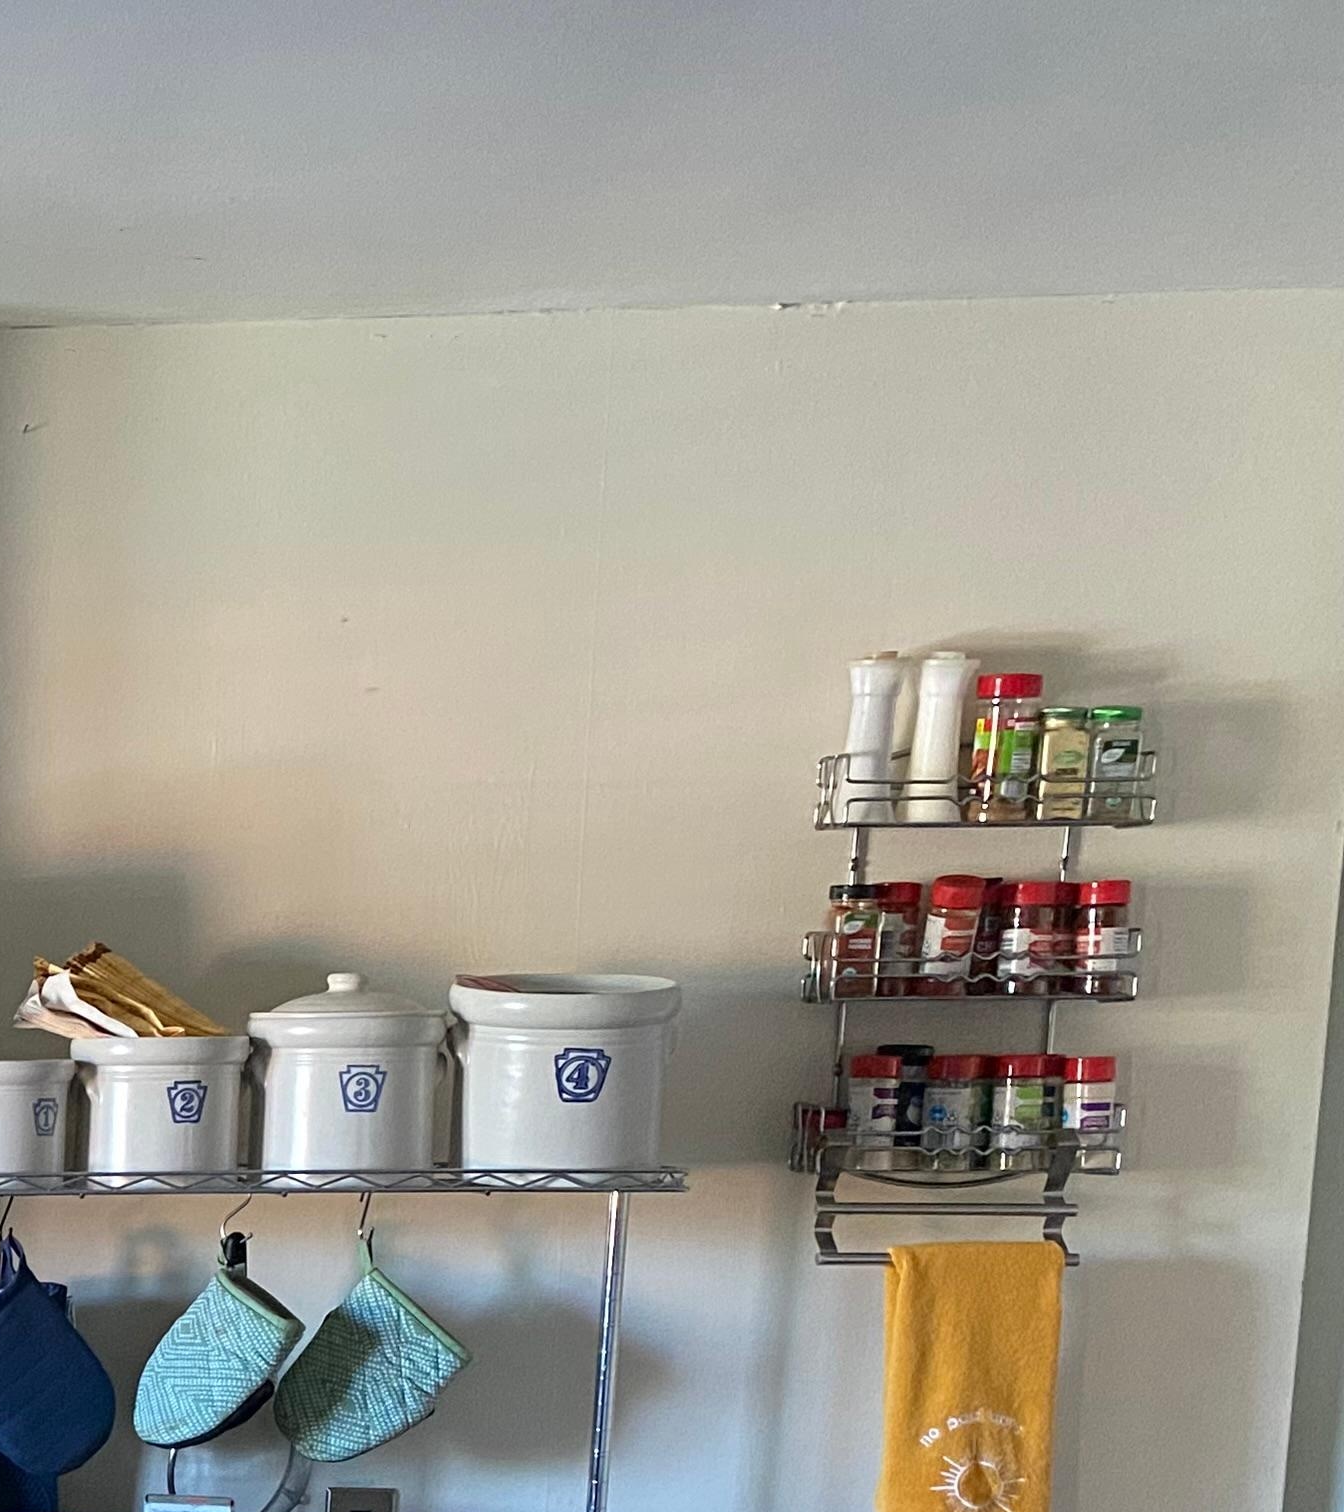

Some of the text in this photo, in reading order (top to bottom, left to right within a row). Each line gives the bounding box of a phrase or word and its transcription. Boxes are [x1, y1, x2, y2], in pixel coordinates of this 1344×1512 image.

[565, 1059, 591, 1090] 4
[354, 1077, 371, 1102] 3
[179, 1091, 196, 1114] 2
